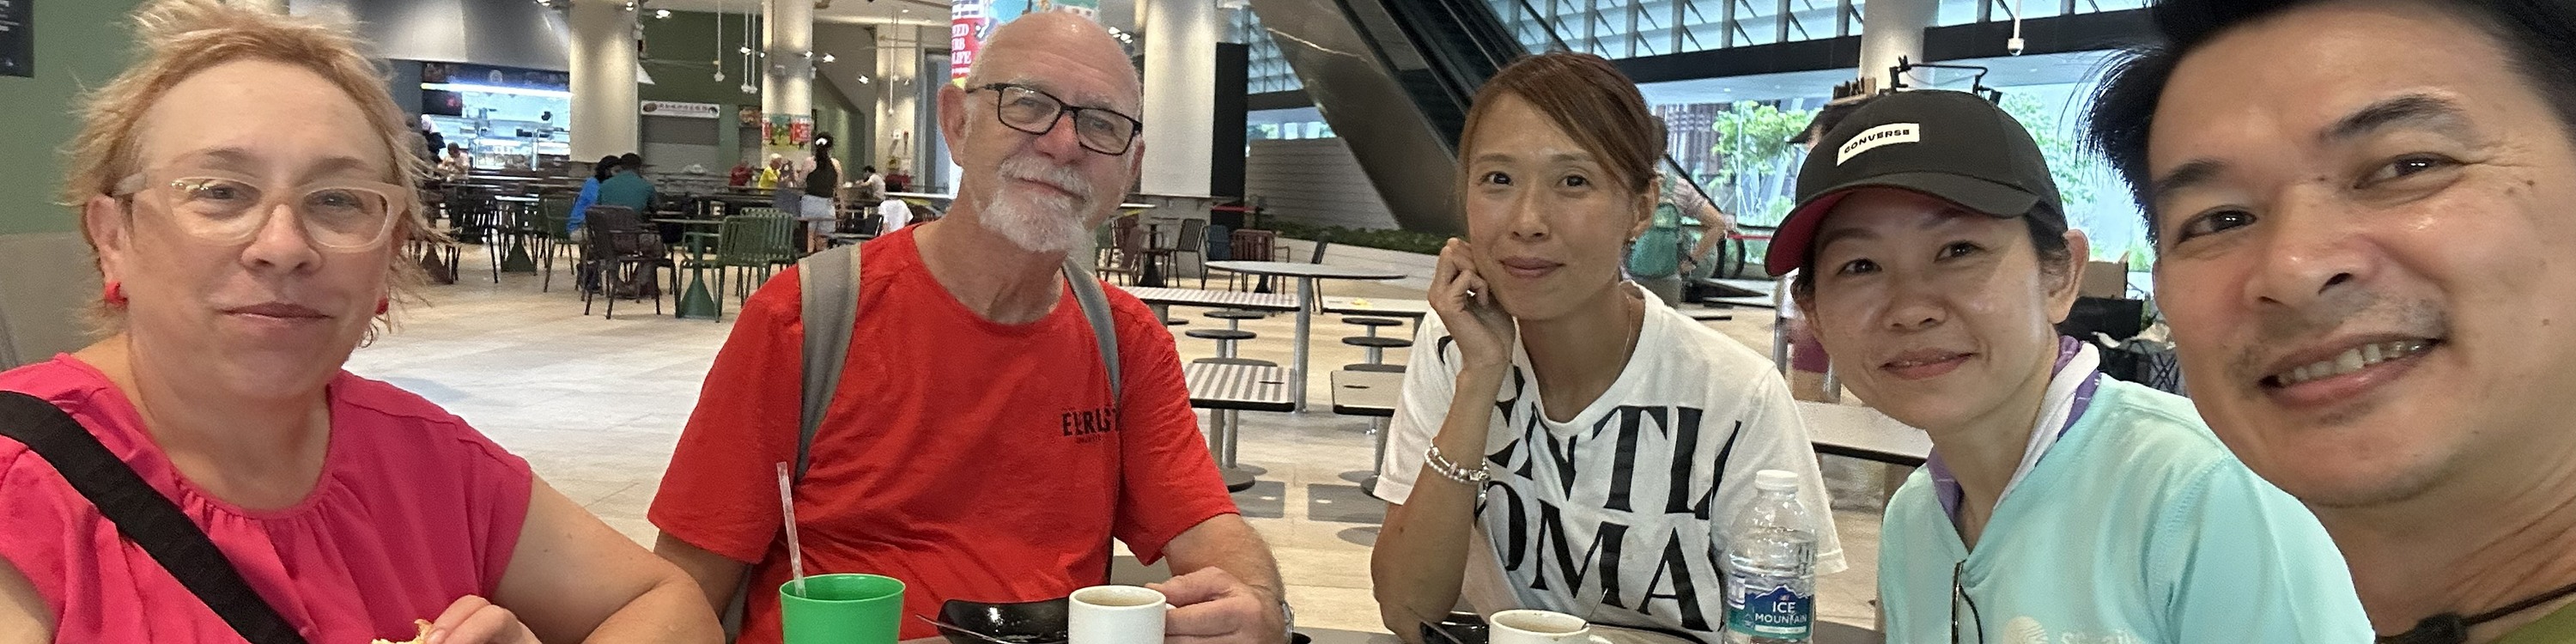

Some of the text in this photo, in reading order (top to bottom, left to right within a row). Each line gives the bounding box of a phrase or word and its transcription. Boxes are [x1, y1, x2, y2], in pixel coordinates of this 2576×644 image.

[1844, 129, 1910, 154] CONVERSE
[1474, 481, 1724, 632] OMA
[1772, 601, 1796, 613] ICE
[1754, 612, 1807, 624] MOUNTAIN
